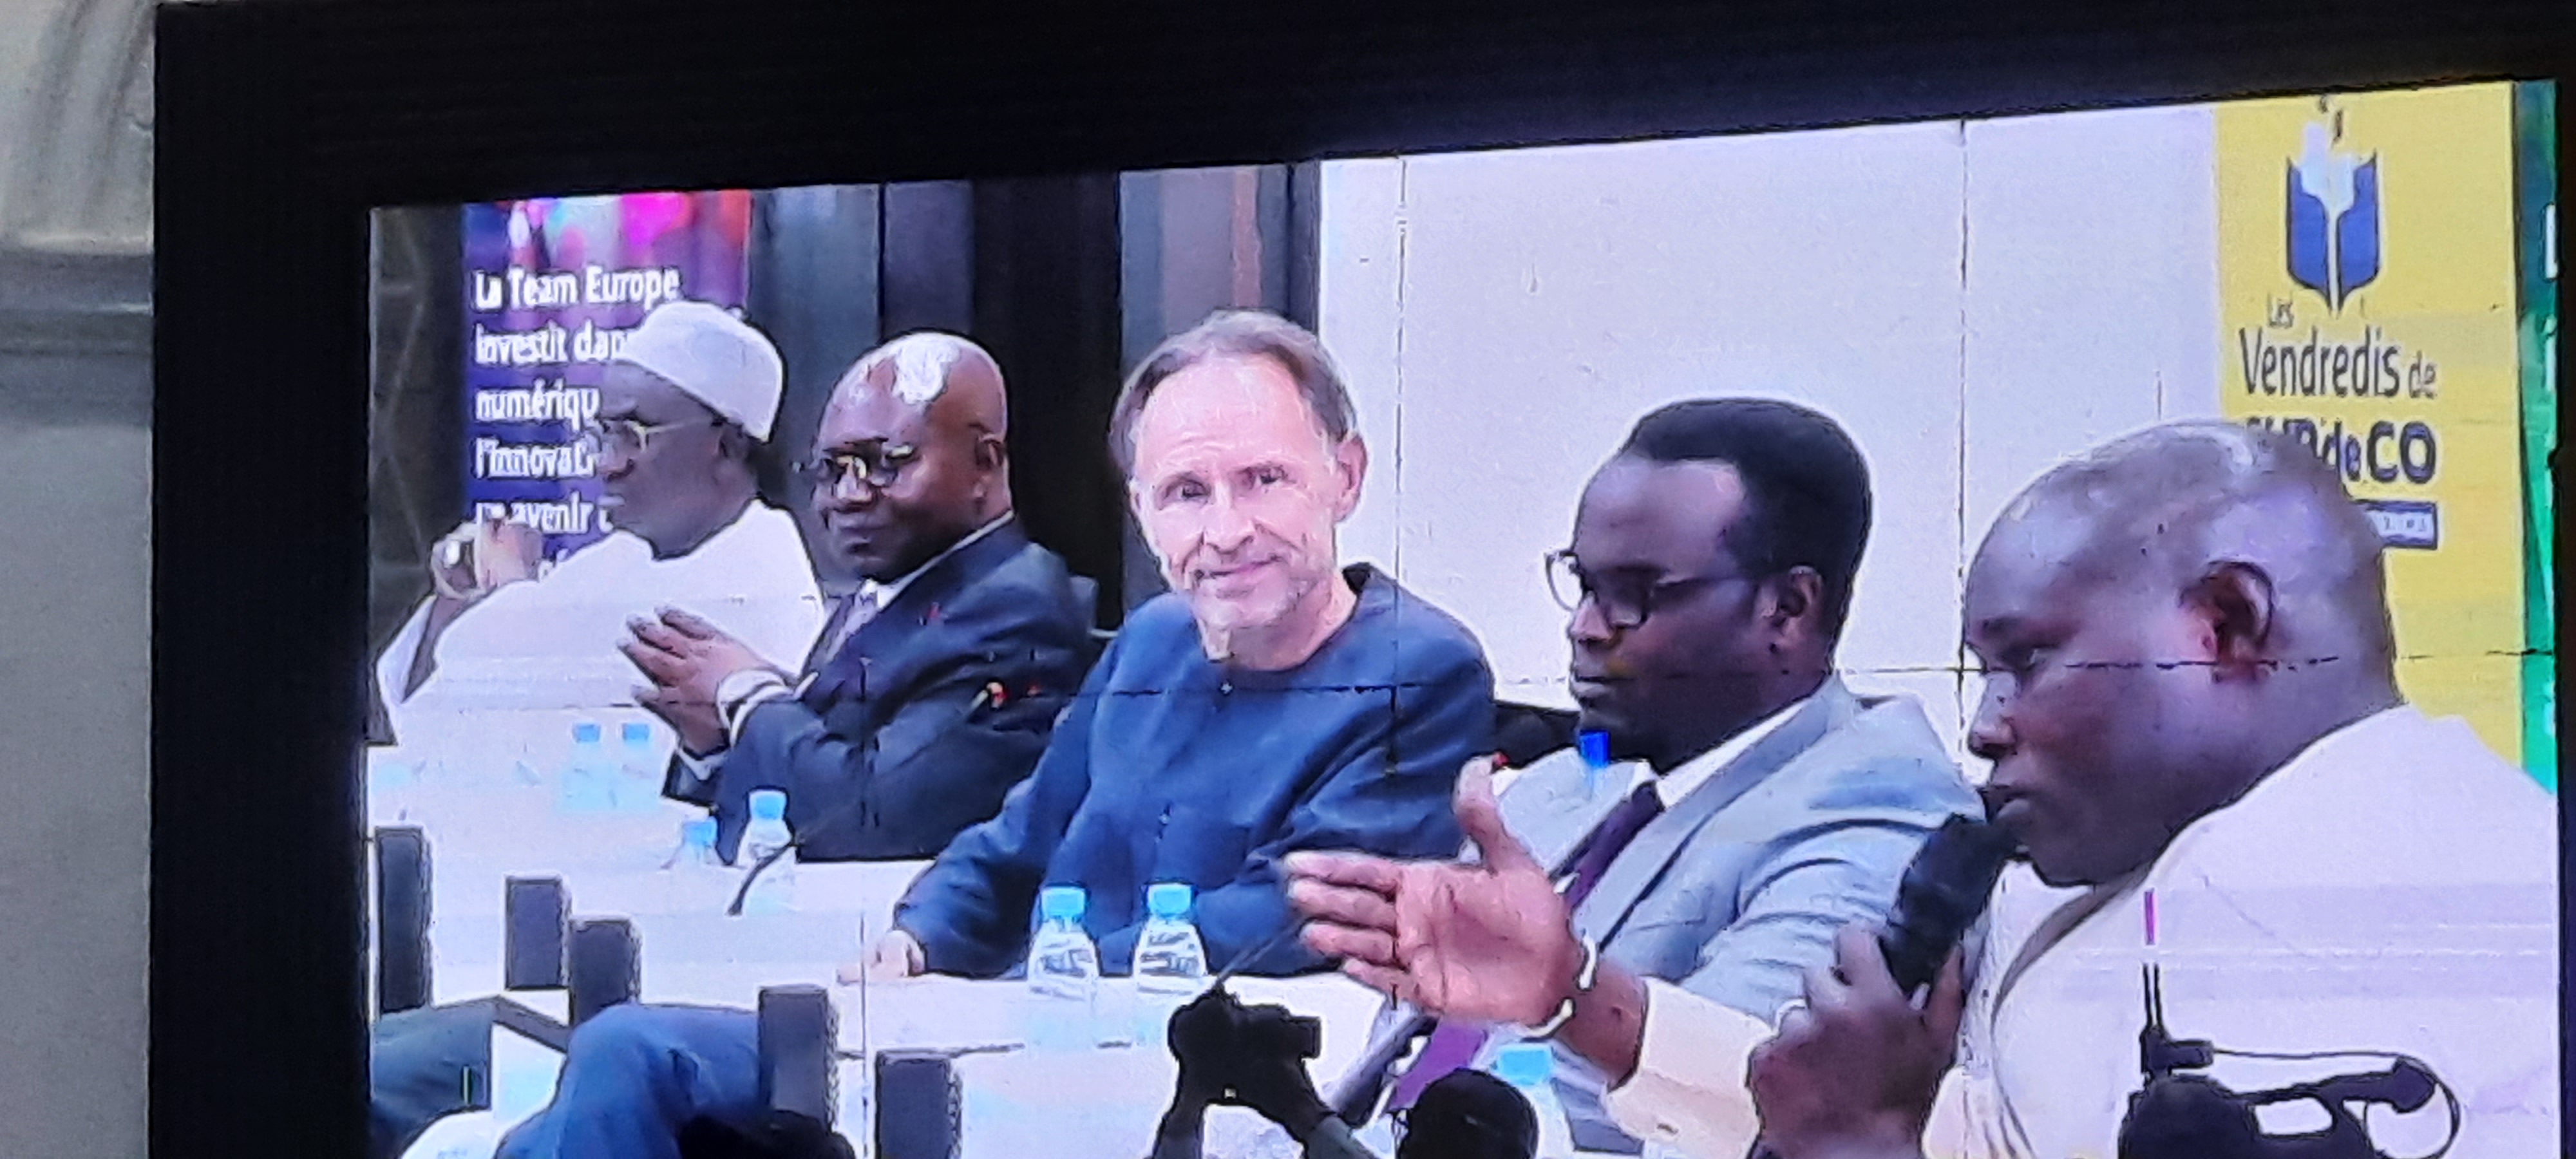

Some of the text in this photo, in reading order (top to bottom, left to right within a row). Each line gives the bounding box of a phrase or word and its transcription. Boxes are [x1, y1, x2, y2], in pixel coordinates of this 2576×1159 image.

[507, 265, 578, 309] Team
[585, 265, 680, 310] Europe
[574, 318, 630, 361] dan
[2239, 325, 2437, 399] Vendredis de
[475, 378, 600, 432] numériqu
[511, 490, 594, 534] avenir
